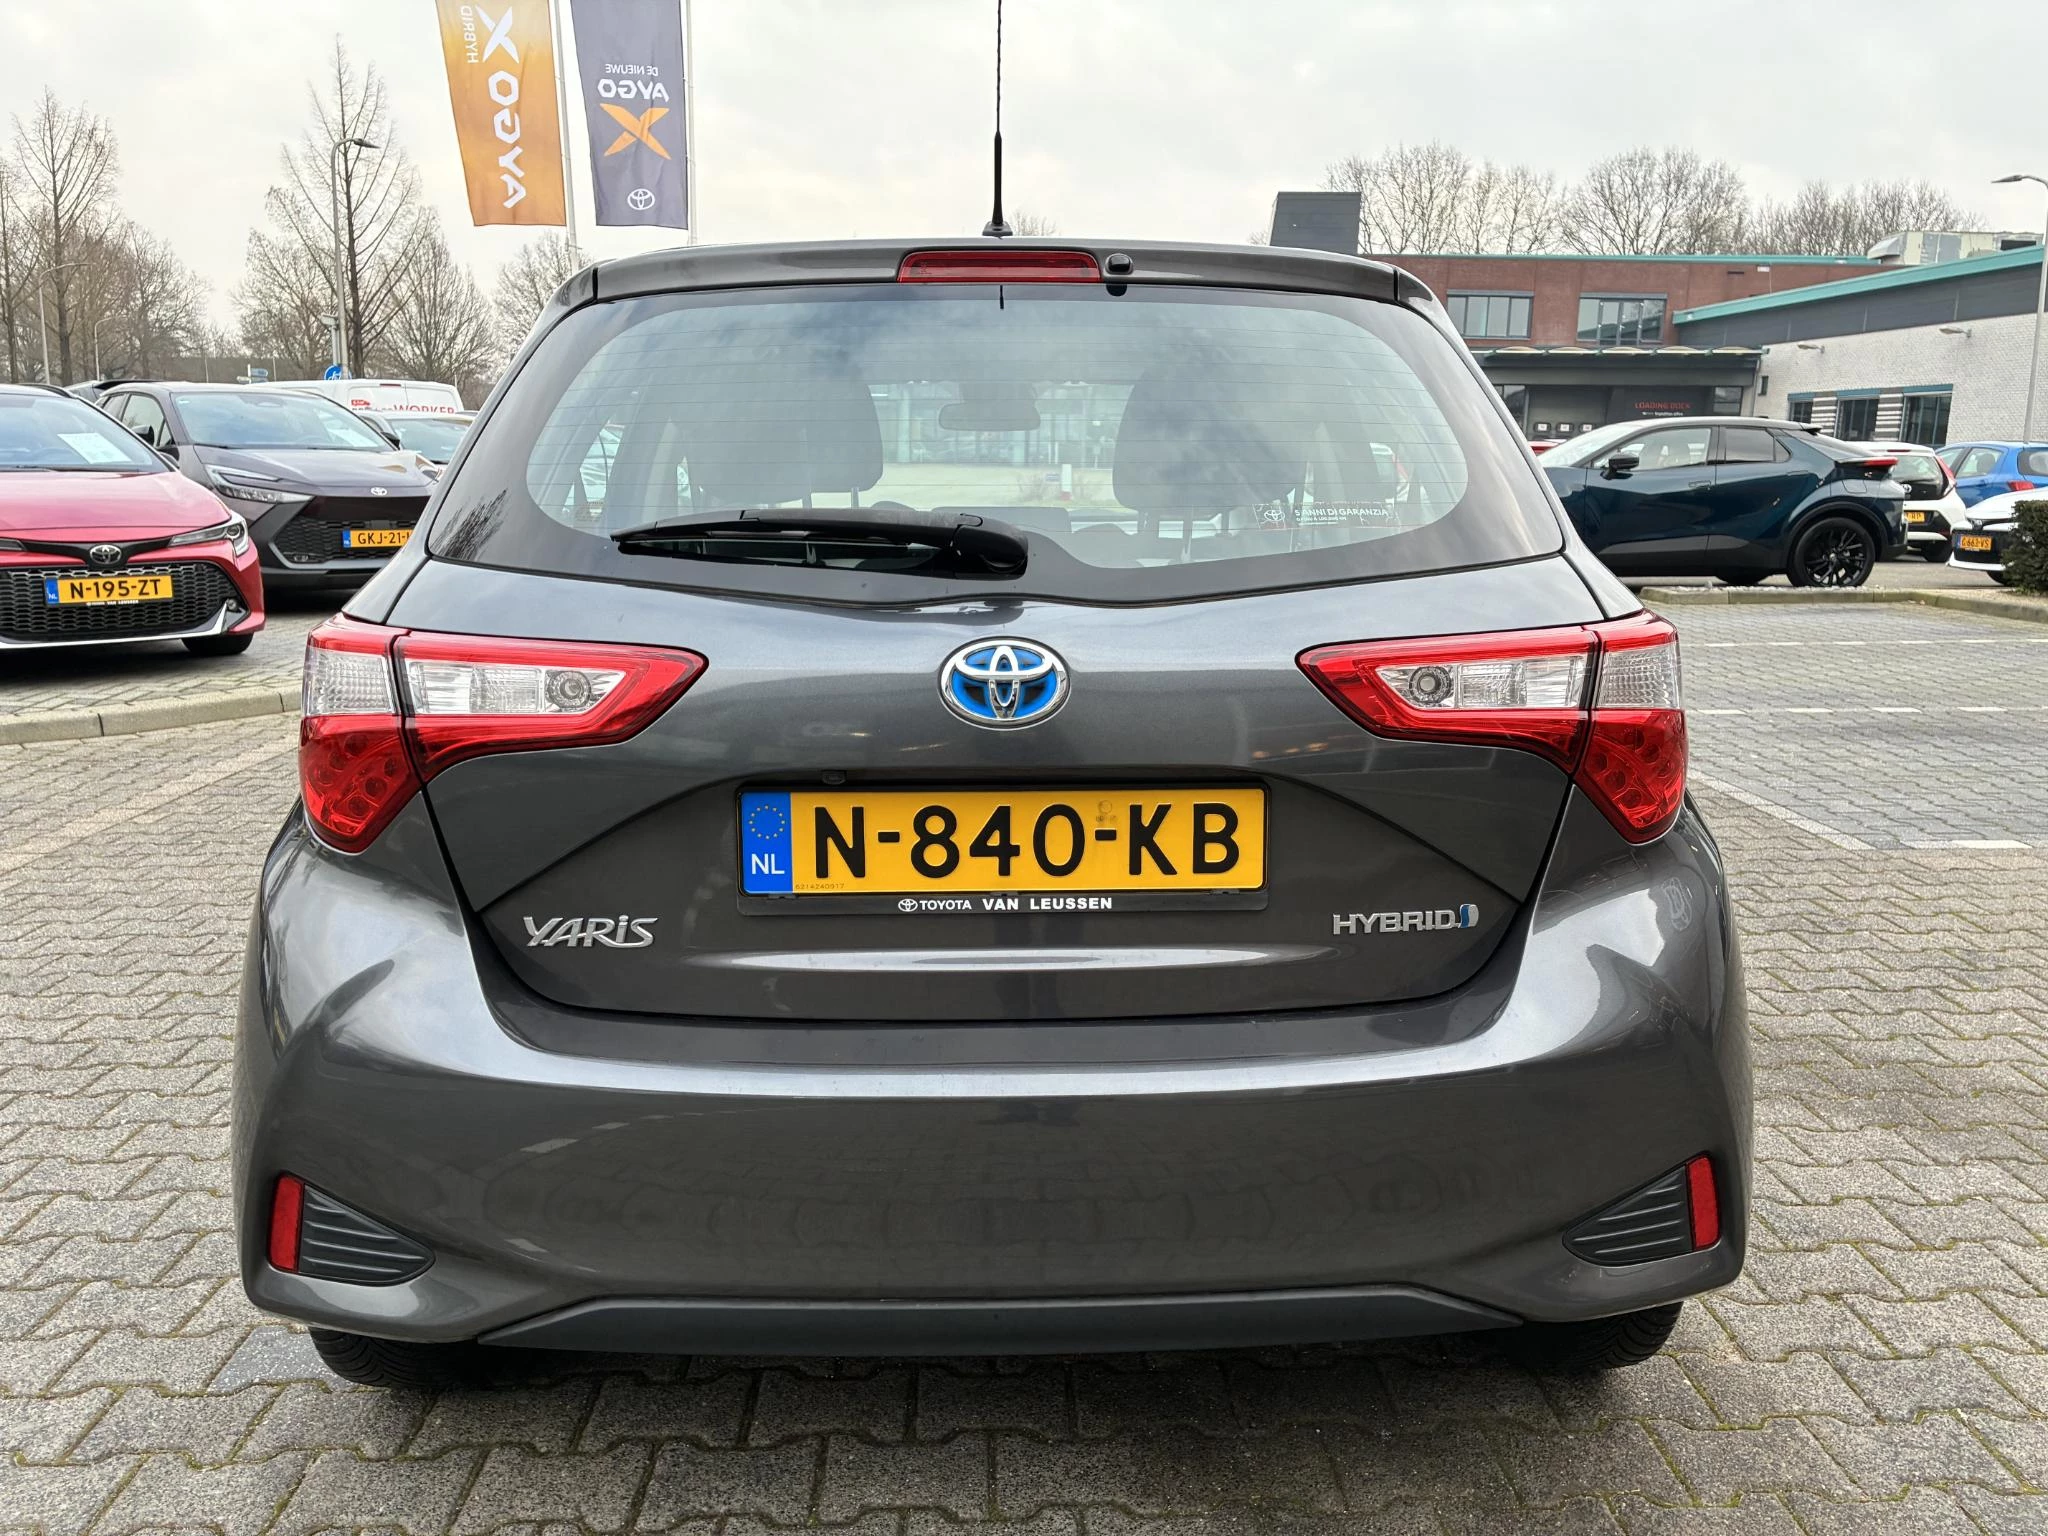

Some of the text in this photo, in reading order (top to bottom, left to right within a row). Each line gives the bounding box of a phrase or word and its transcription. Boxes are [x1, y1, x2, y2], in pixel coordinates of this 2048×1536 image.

[70, 579, 161, 599] N-195-ZT
[814, 802, 1240, 879] N-840-KB
[751, 853, 785, 875] NL
[919, 897, 1113, 911] TOYOTA VAN LEUSSEN
[1333, 910, 1456, 935] HYBRID
